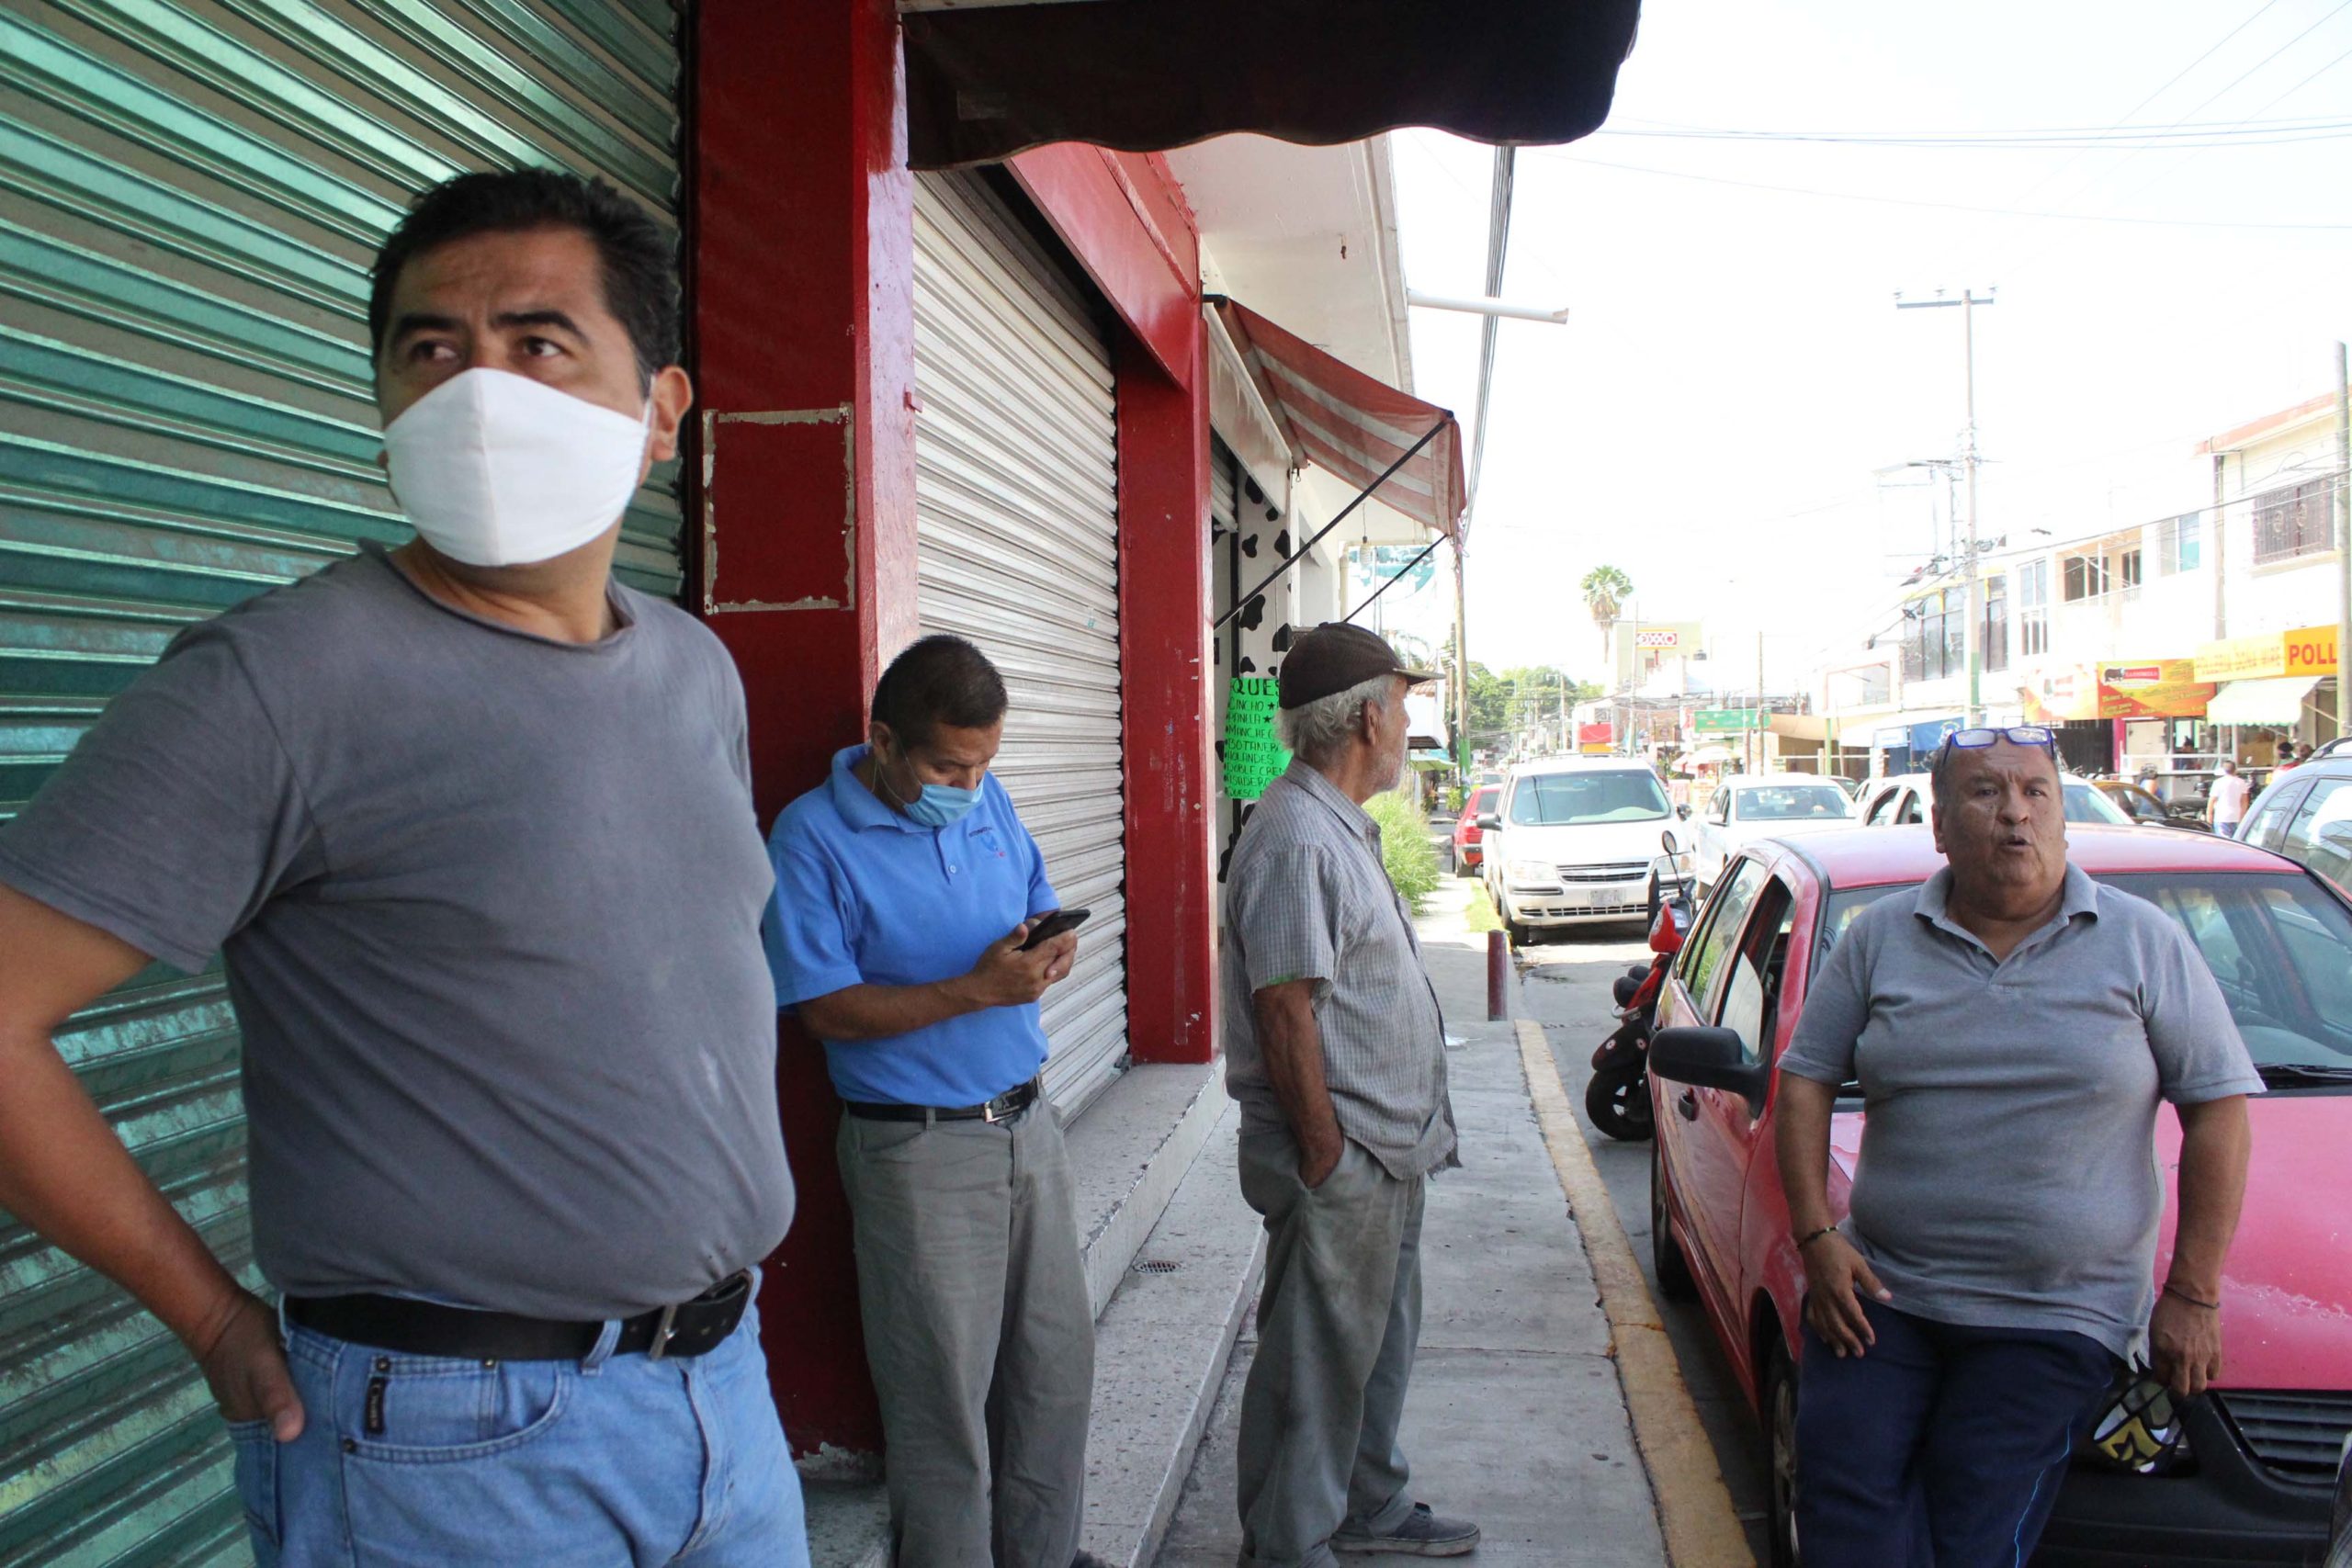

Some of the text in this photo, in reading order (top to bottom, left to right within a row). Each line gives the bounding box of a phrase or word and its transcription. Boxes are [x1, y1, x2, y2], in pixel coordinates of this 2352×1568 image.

[1636, 632, 1677, 647] OXXO
[2289, 643, 2337, 665] POLL
[1229, 696, 1264, 712] CINCHO
